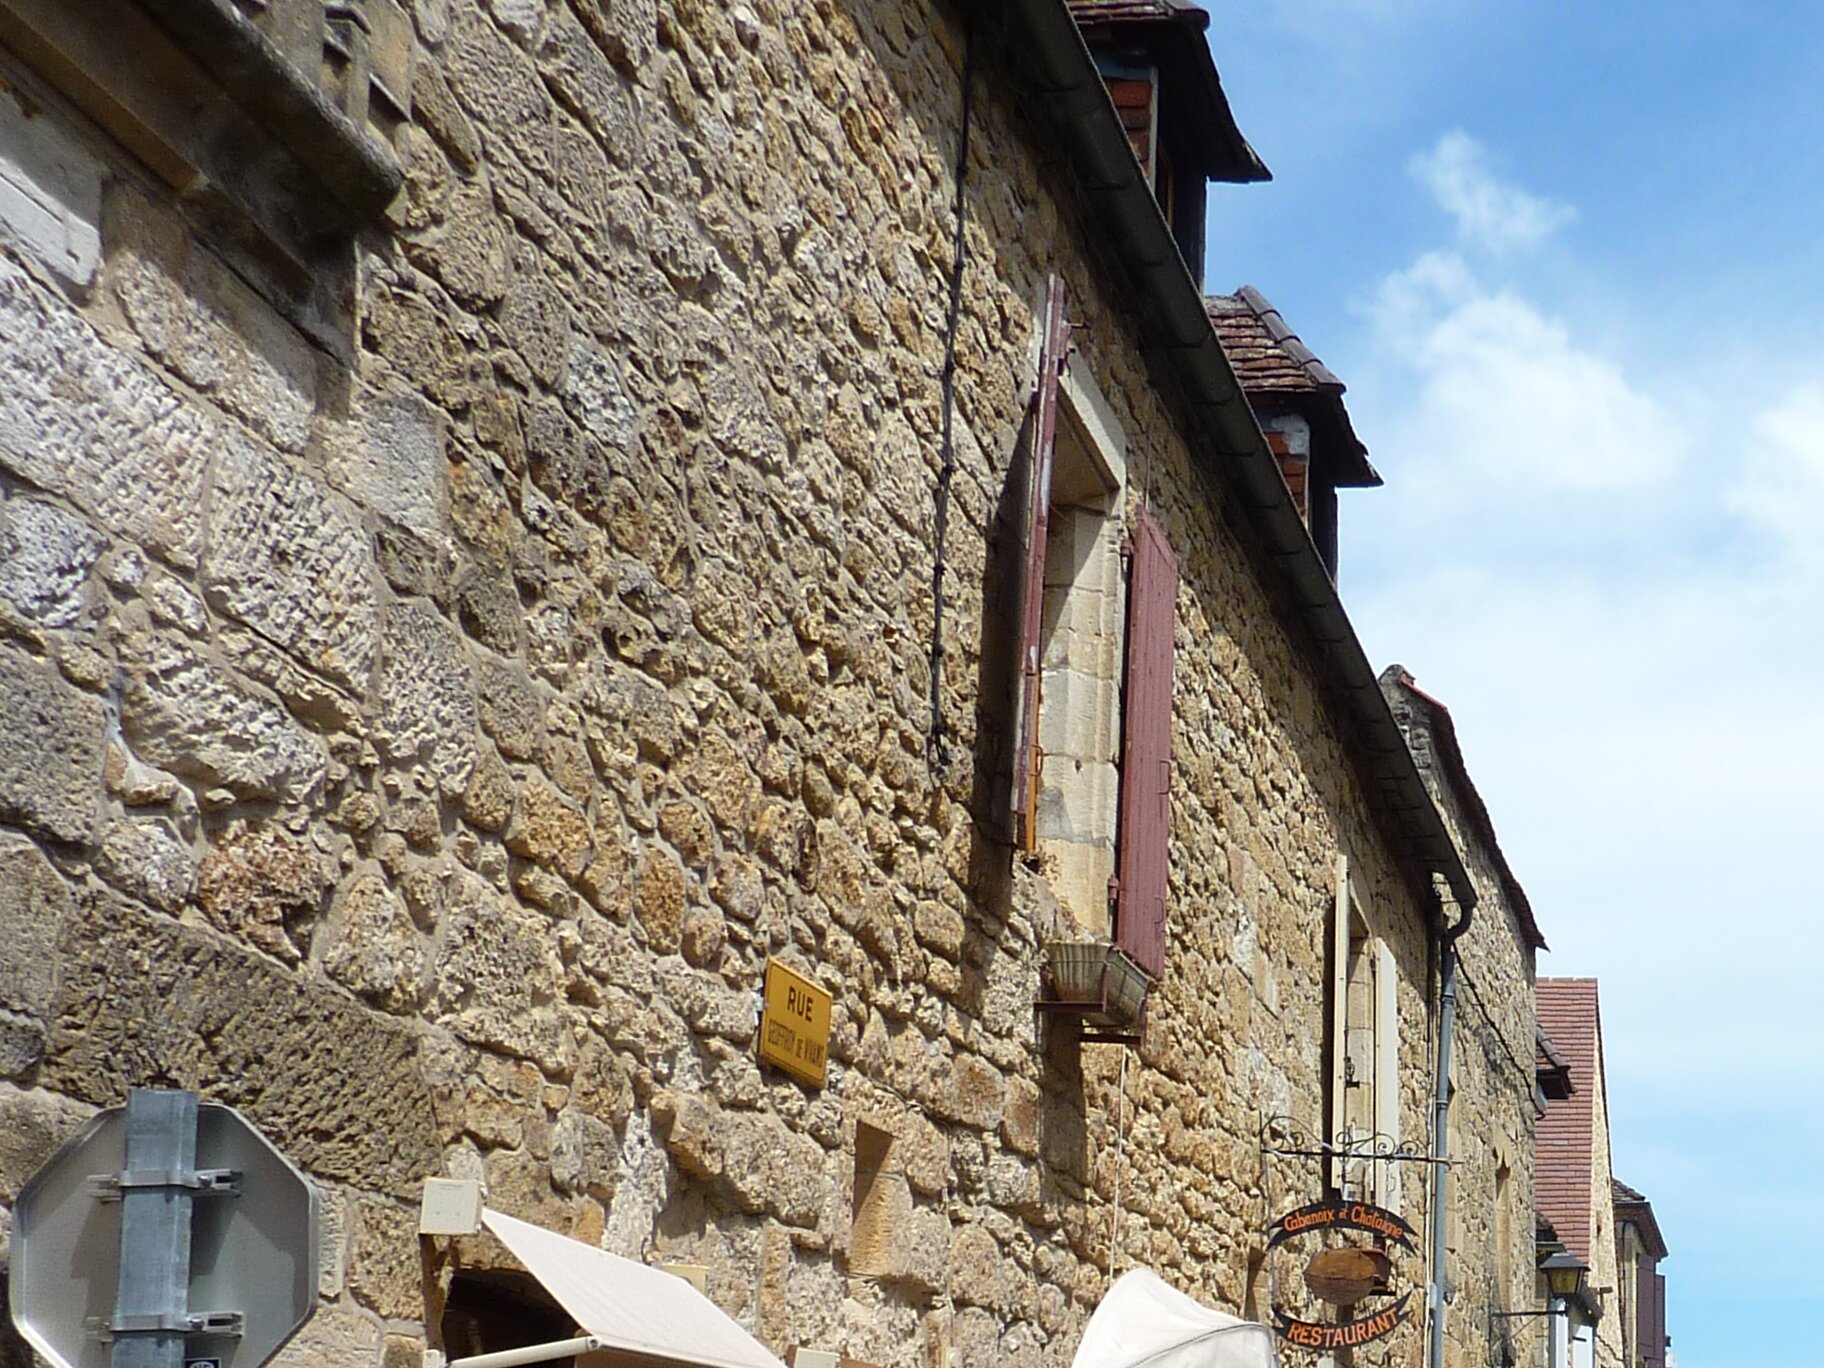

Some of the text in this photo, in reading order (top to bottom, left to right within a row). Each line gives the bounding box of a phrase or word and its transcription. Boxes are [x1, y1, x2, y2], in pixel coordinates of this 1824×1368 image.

[787, 986, 814, 1022] RUE
[1284, 1207, 1335, 1232] Cabanoix
[1287, 1307, 1400, 1348] RESTAURANT
